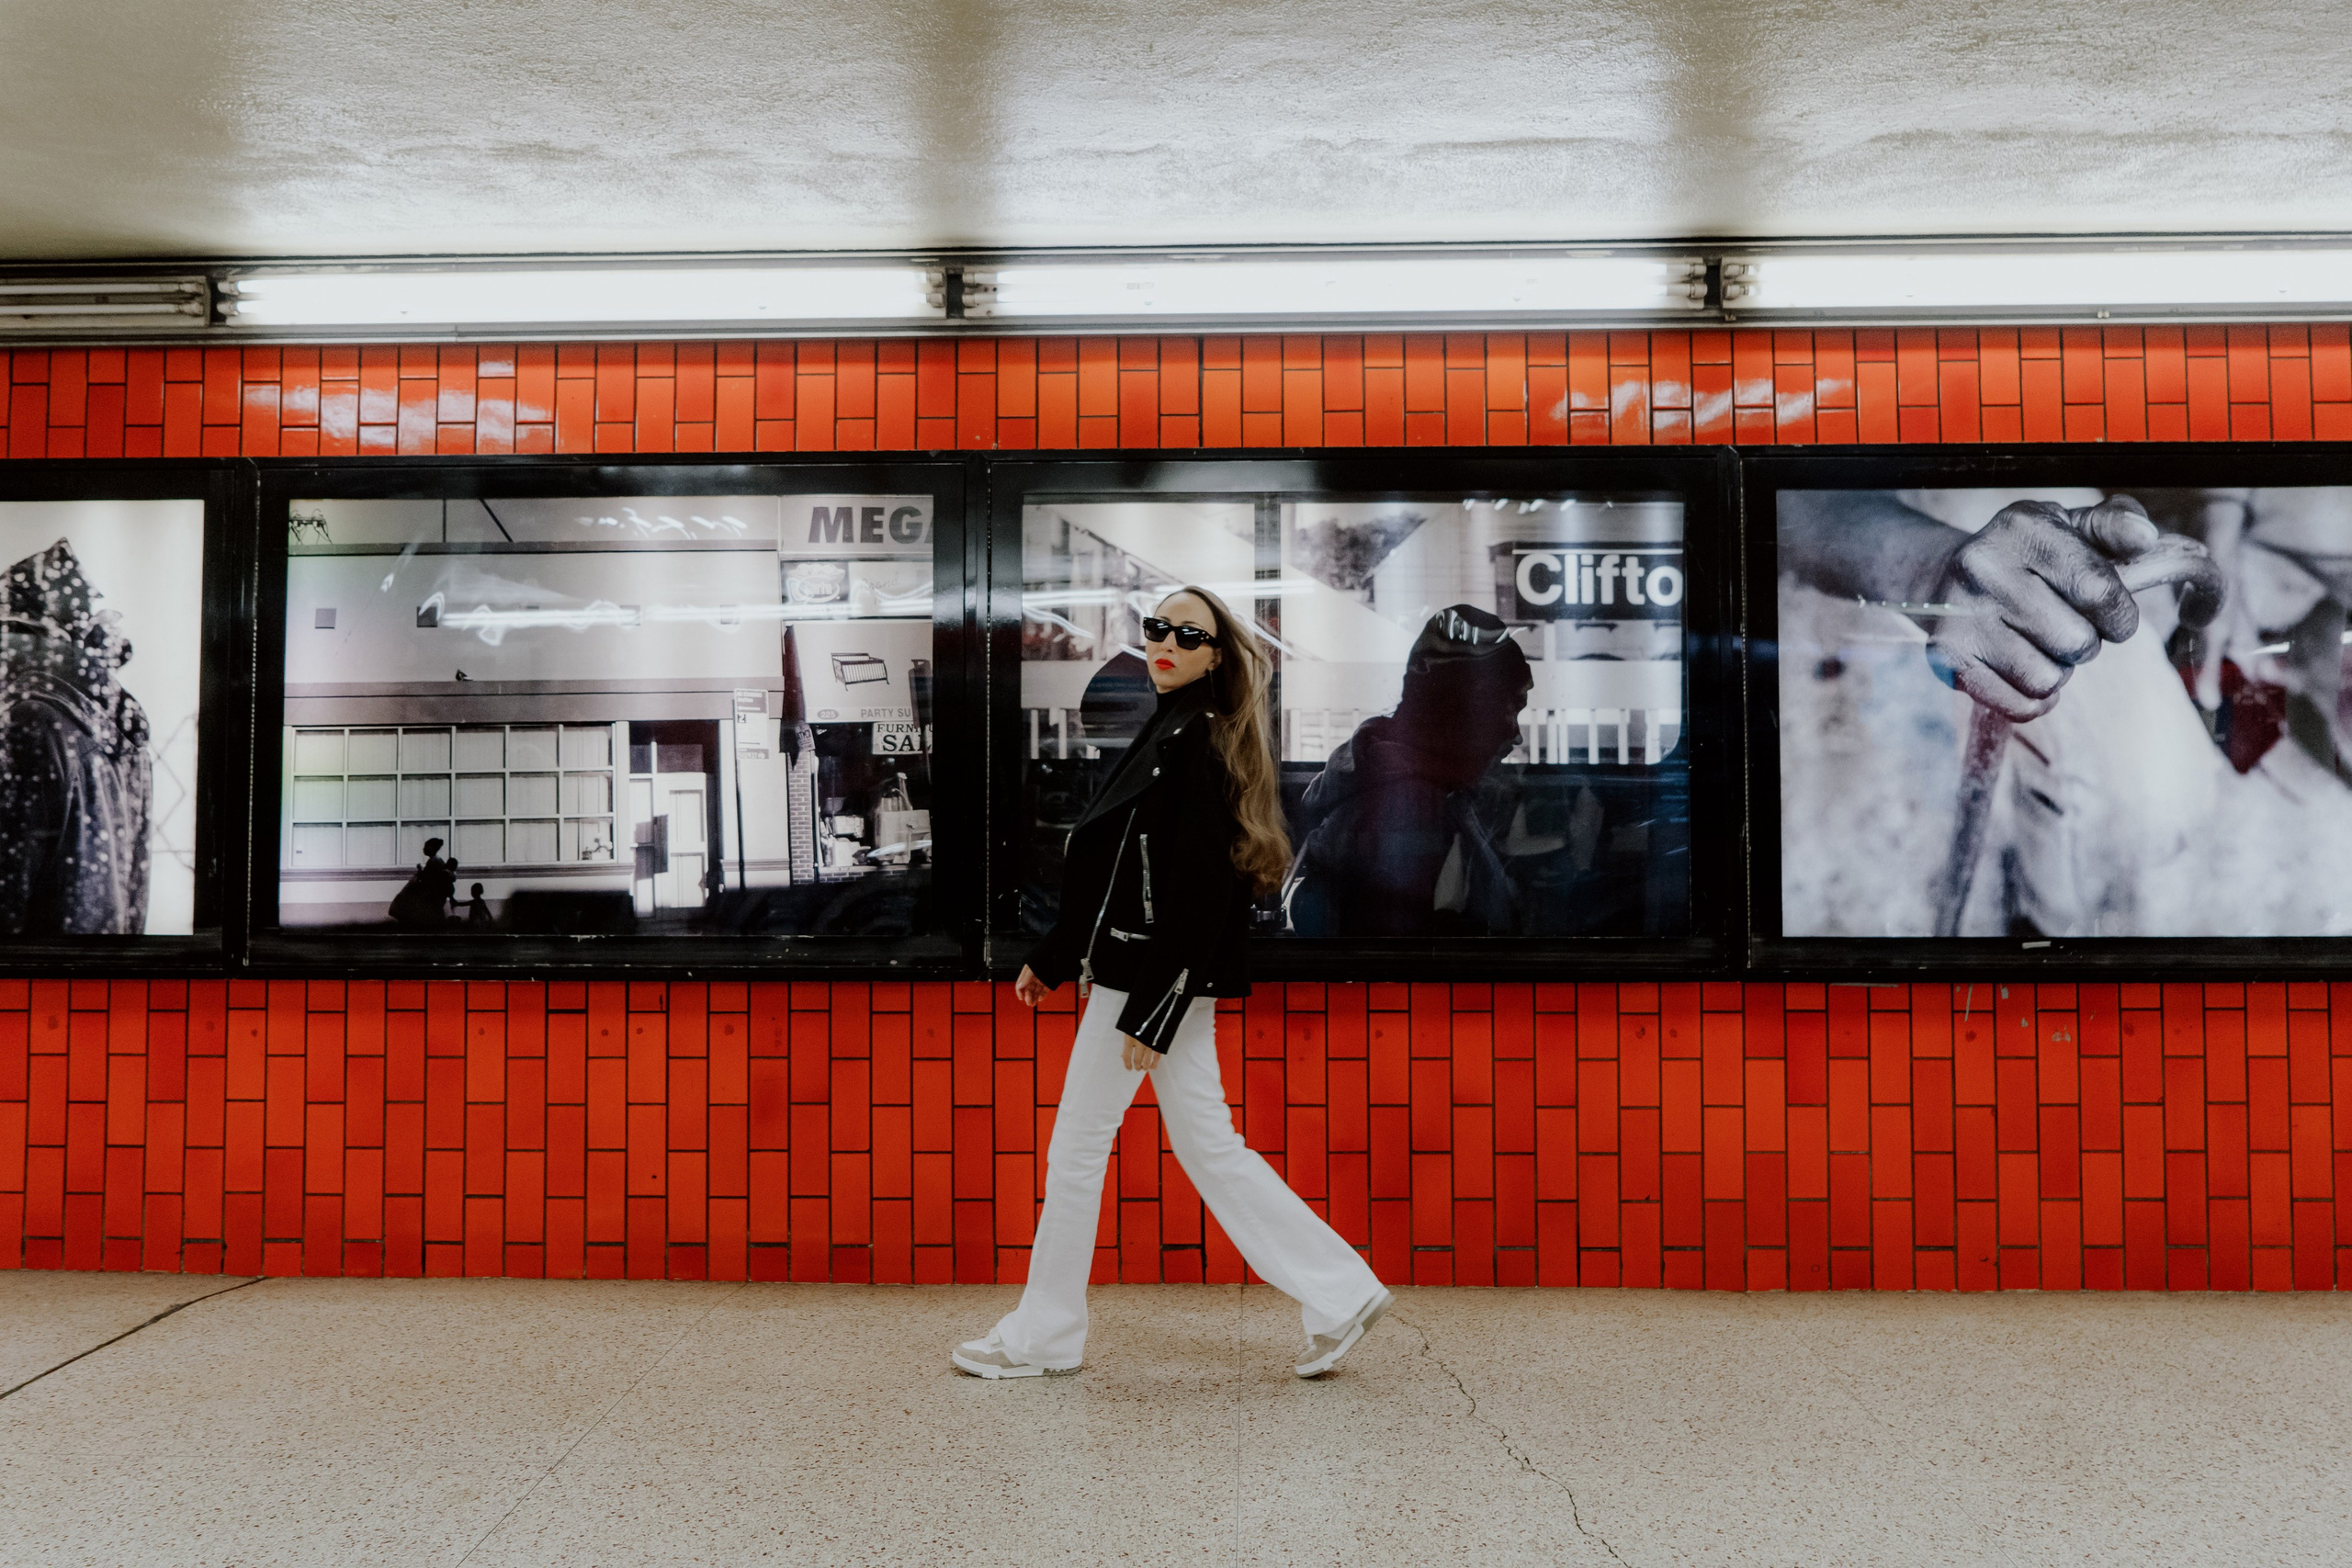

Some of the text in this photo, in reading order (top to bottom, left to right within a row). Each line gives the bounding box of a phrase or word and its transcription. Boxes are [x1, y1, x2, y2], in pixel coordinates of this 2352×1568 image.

[808, 506, 933, 544] MEG
[1516, 553, 1683, 606] Clifto
[861, 707, 911, 718] PARTY SU
